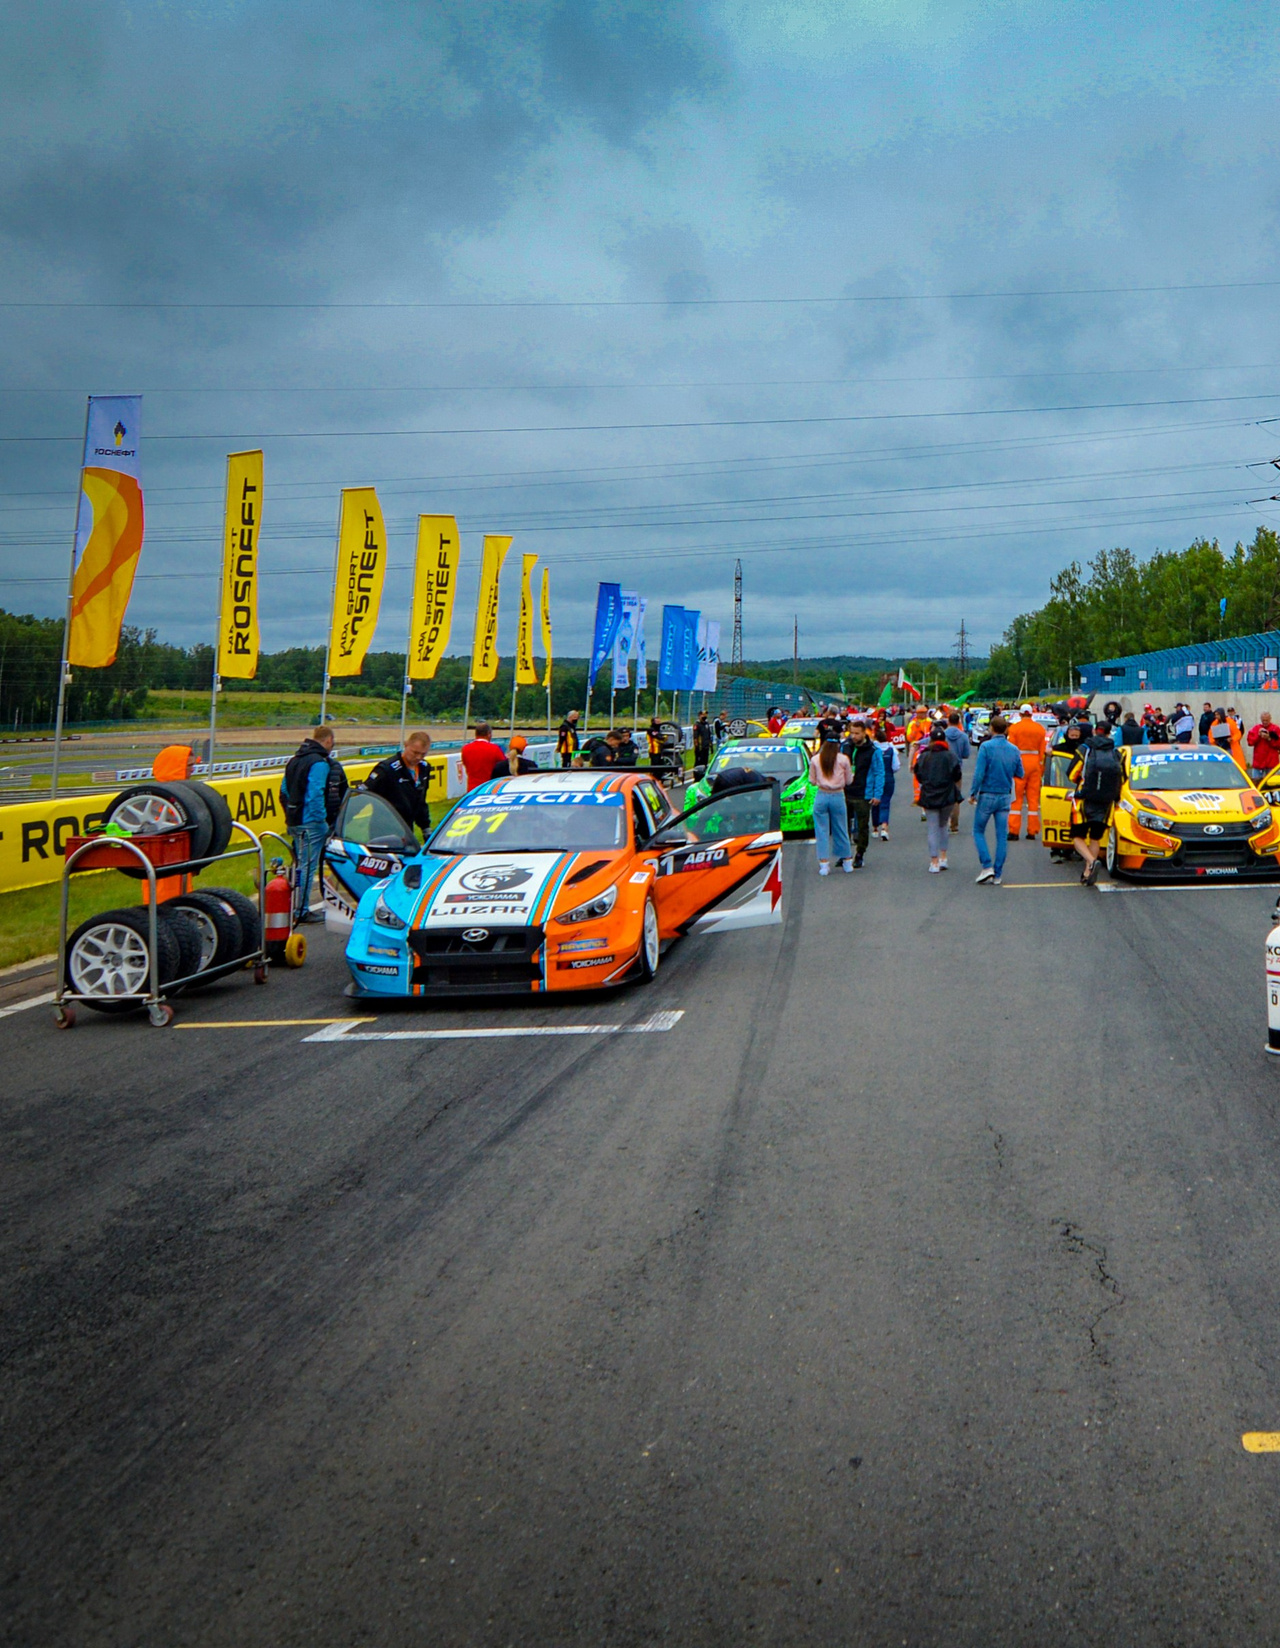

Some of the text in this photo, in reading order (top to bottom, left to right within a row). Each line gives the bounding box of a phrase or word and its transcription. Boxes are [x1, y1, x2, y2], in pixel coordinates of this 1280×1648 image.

[235, 477, 257, 655] ROSNEFT
[339, 551, 359, 657] LADA SPORT
[422, 533, 451, 662] ROSNEFT
[418, 570, 434, 661] LADA SPORT
[1135, 753, 1226, 763] BETCITY
[1130, 764, 1149, 781] 11
[467, 792, 618, 806] BETCITY
[1264, 790, 1280, 803] 11
[446, 812, 509, 837] 91
[360, 857, 388, 871] АВТО
[684, 849, 725, 865] АВТО
[1205, 867, 1239, 875] YOKOHAMA
[467, 893, 518, 901] YOKOHAMA
[431, 905, 529, 916] LUZAR
[570, 956, 613, 969] YOKOHAMA
[365, 965, 398, 975] YOKOHAMA
